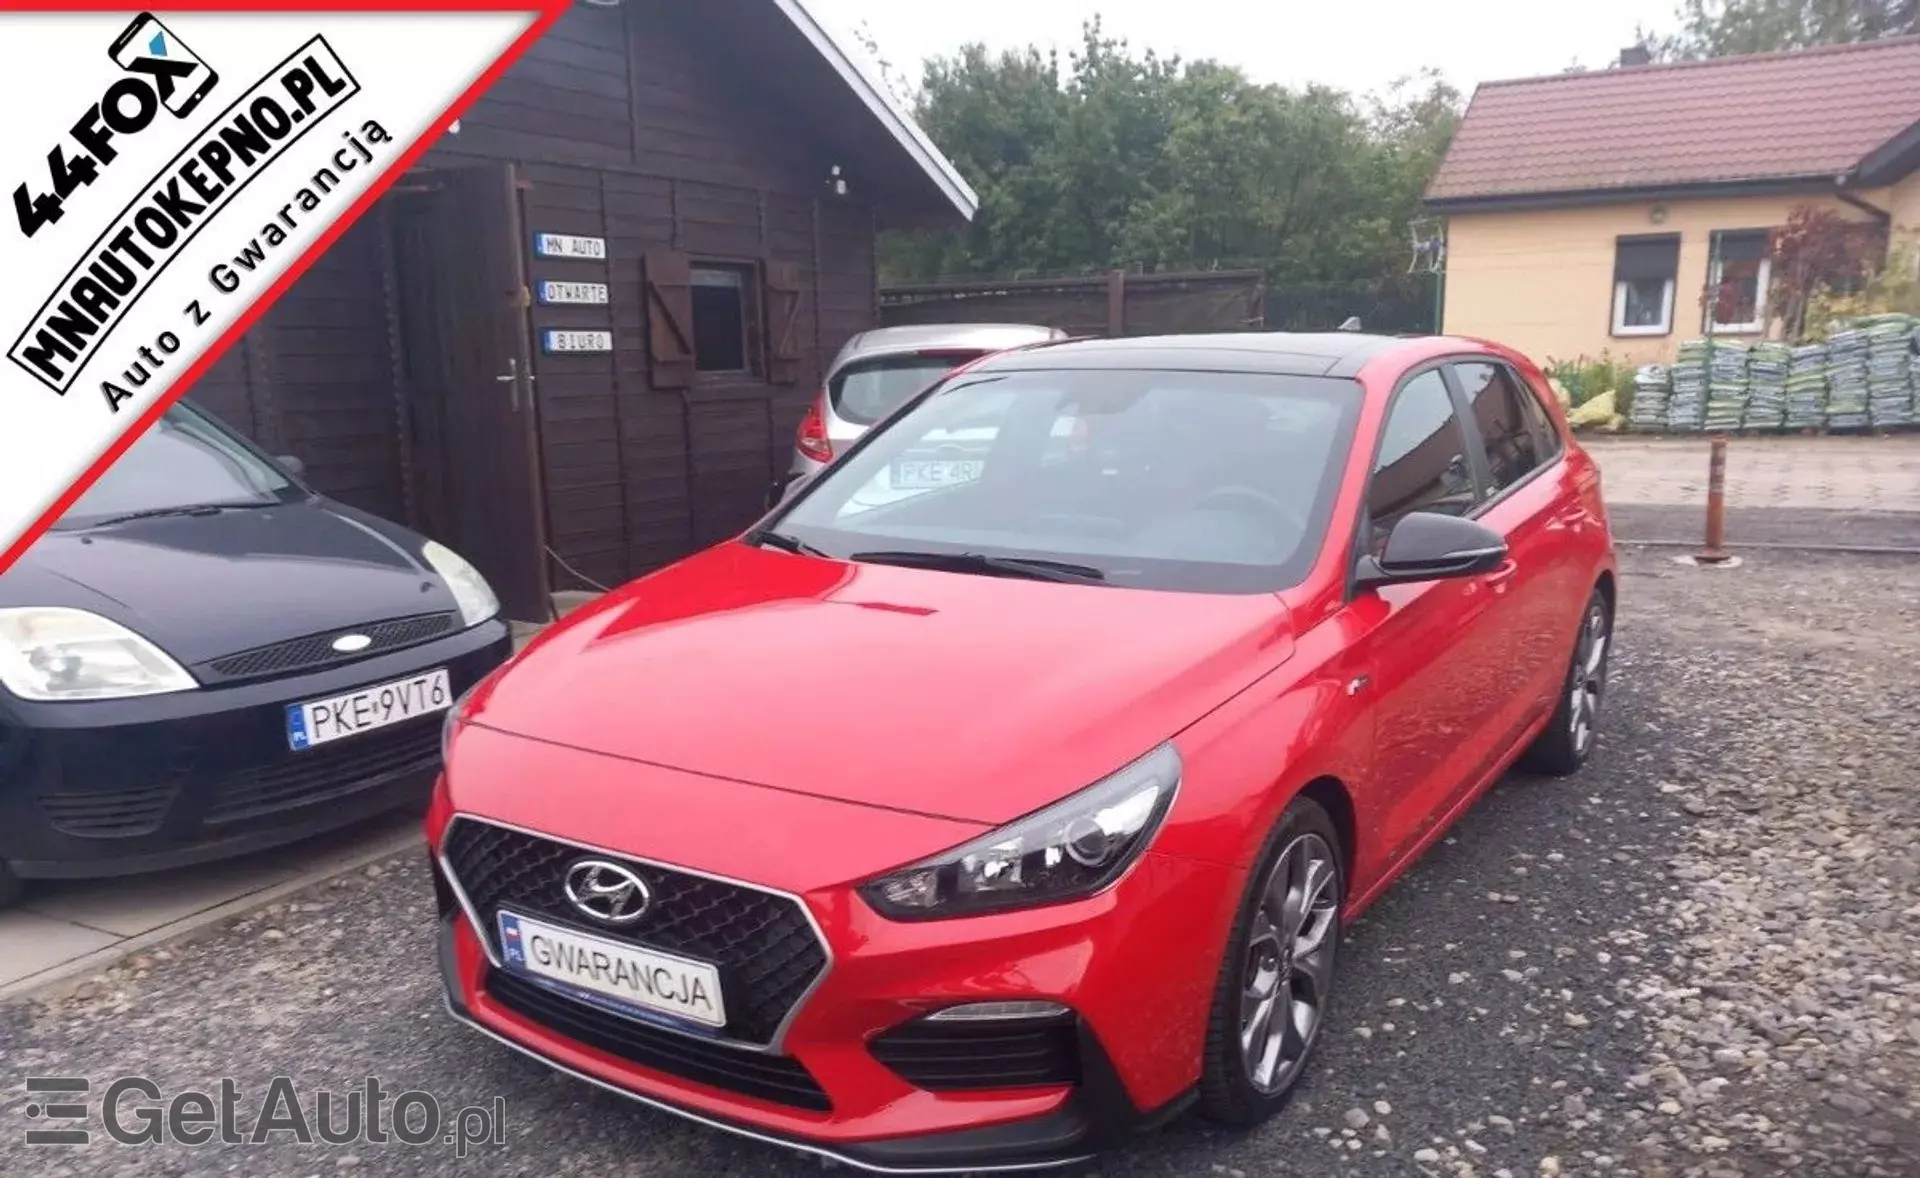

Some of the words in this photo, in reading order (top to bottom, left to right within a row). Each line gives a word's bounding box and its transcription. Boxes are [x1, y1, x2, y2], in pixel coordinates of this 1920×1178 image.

[572, 239, 602, 256] AUTO
[547, 283, 607, 302] OTWARTE
[556, 333, 605, 350] BIURO
[311, 694, 373, 739] PKE
[380, 674, 445, 721] 9VT6
[530, 934, 713, 1012] GWARANCJA
